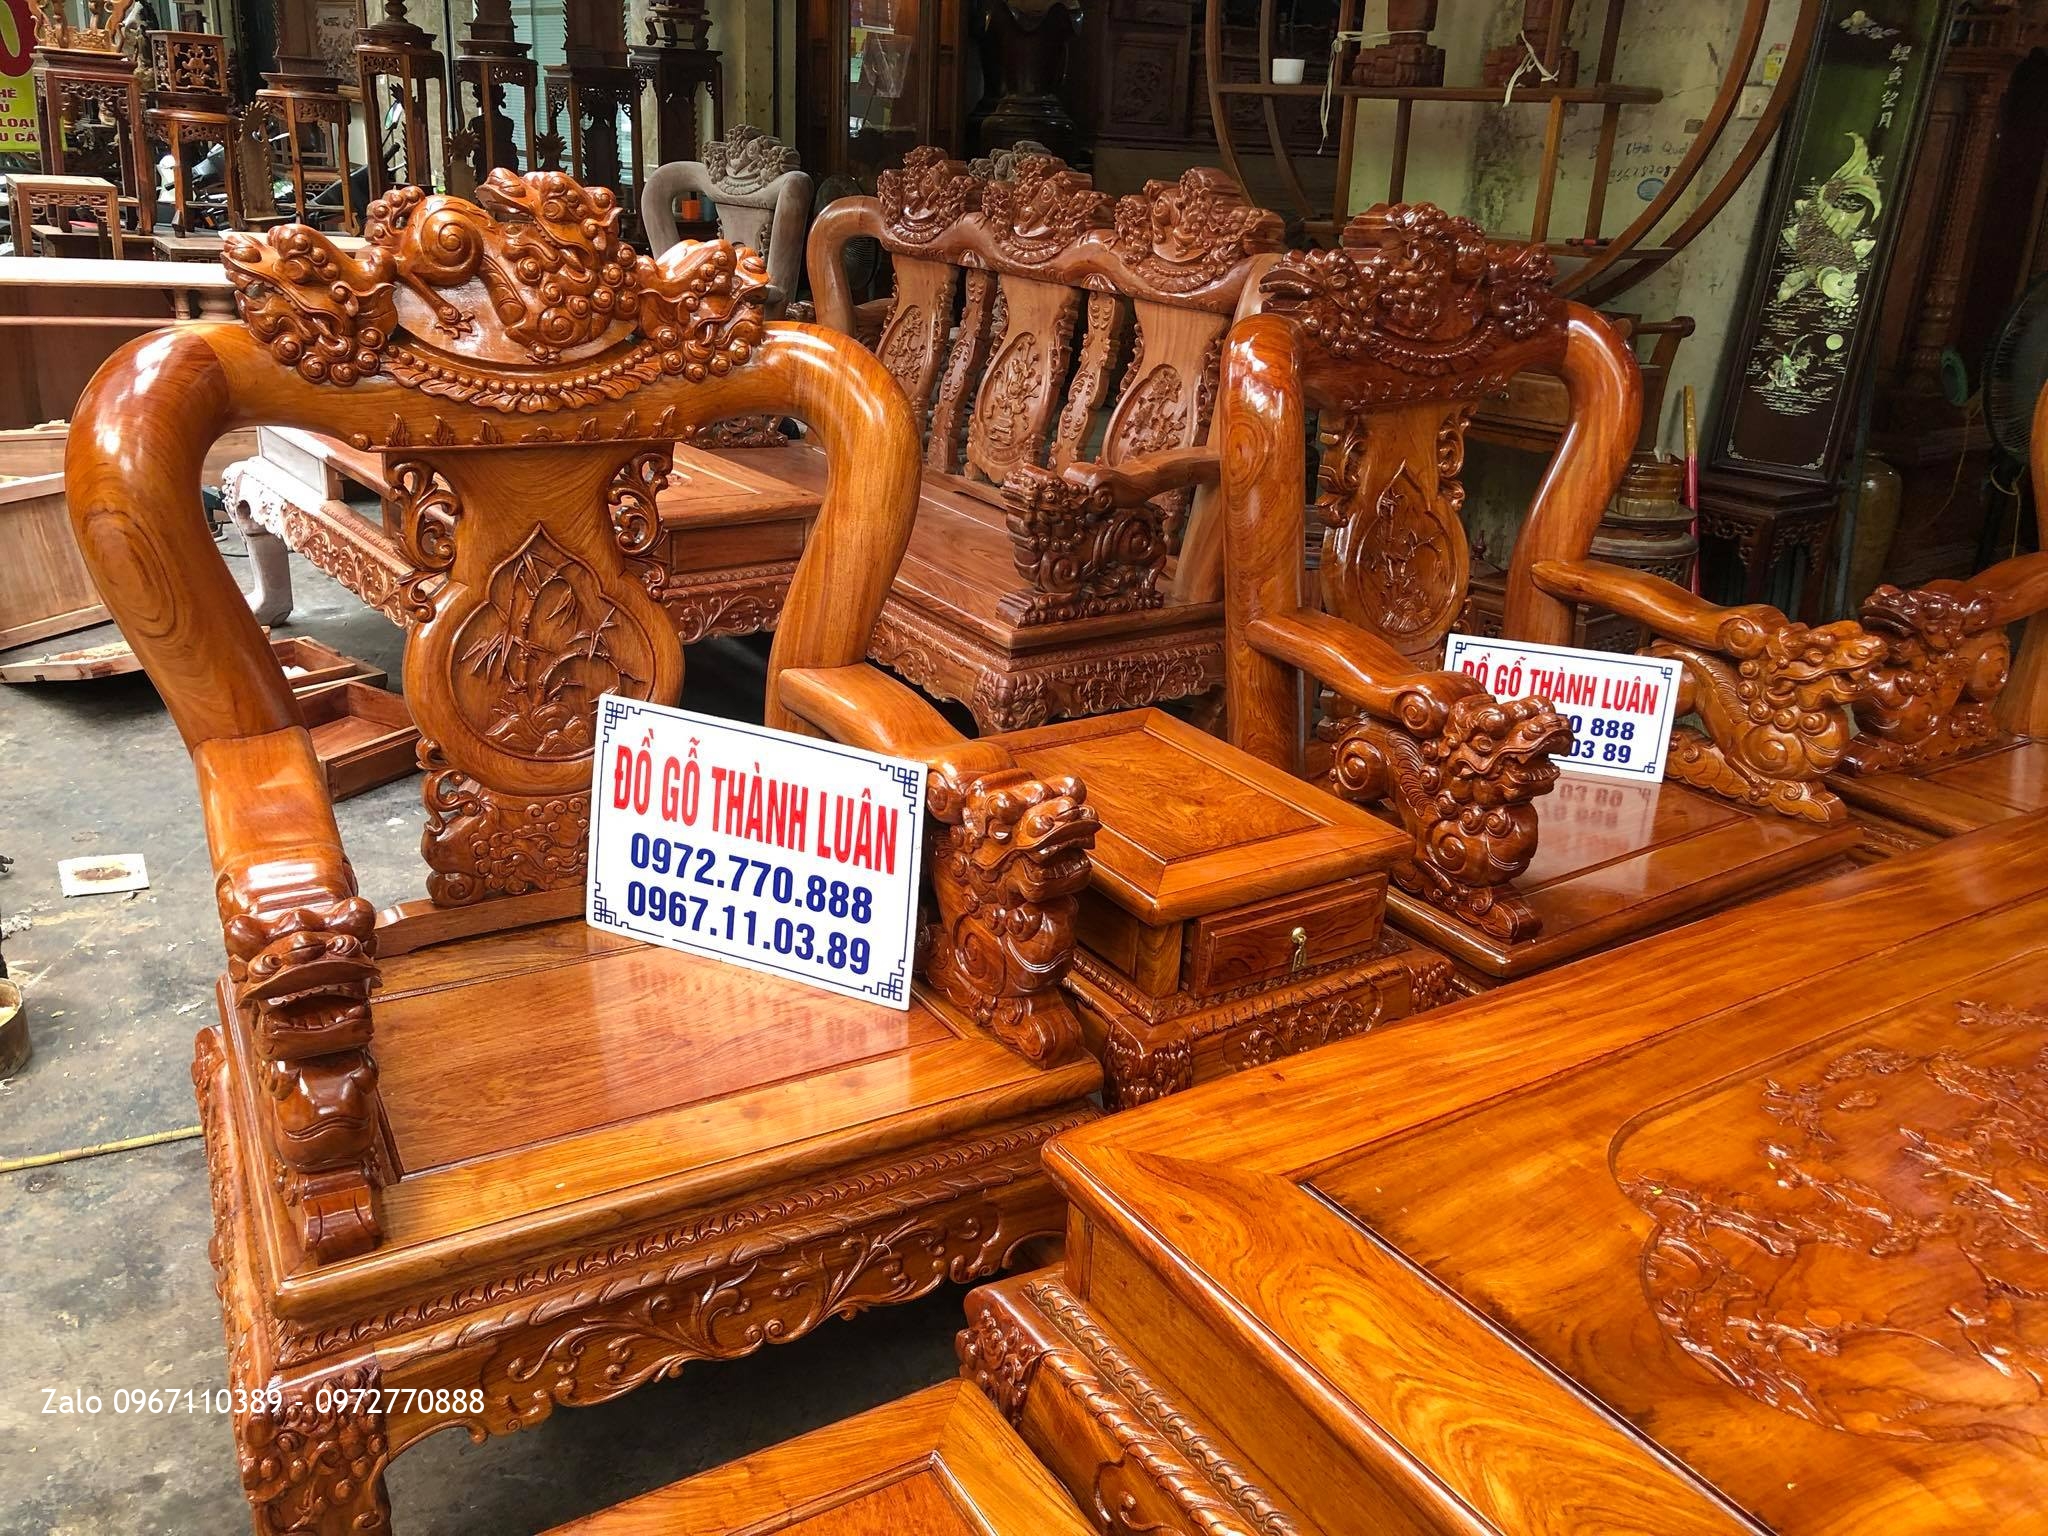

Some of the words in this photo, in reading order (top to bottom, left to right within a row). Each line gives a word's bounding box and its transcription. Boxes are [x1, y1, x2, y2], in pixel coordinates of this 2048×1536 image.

[1494, 657, 1526, 697] GỖ
[1528, 667, 1597, 707] THÀNH
[1601, 676, 1659, 715] LUÂN
[1590, 718, 1635, 741] 888
[1602, 743, 1632, 764] 89
[613, 729, 654, 816] ĐỒ
[661, 737, 701, 827] GỖ
[711, 762, 809, 853] THÀNH
[816, 788, 899, 876] LUÂN
[630, 832, 873, 924] 0972.770.888
[627, 881, 870, 976] 0967.11.03.89
